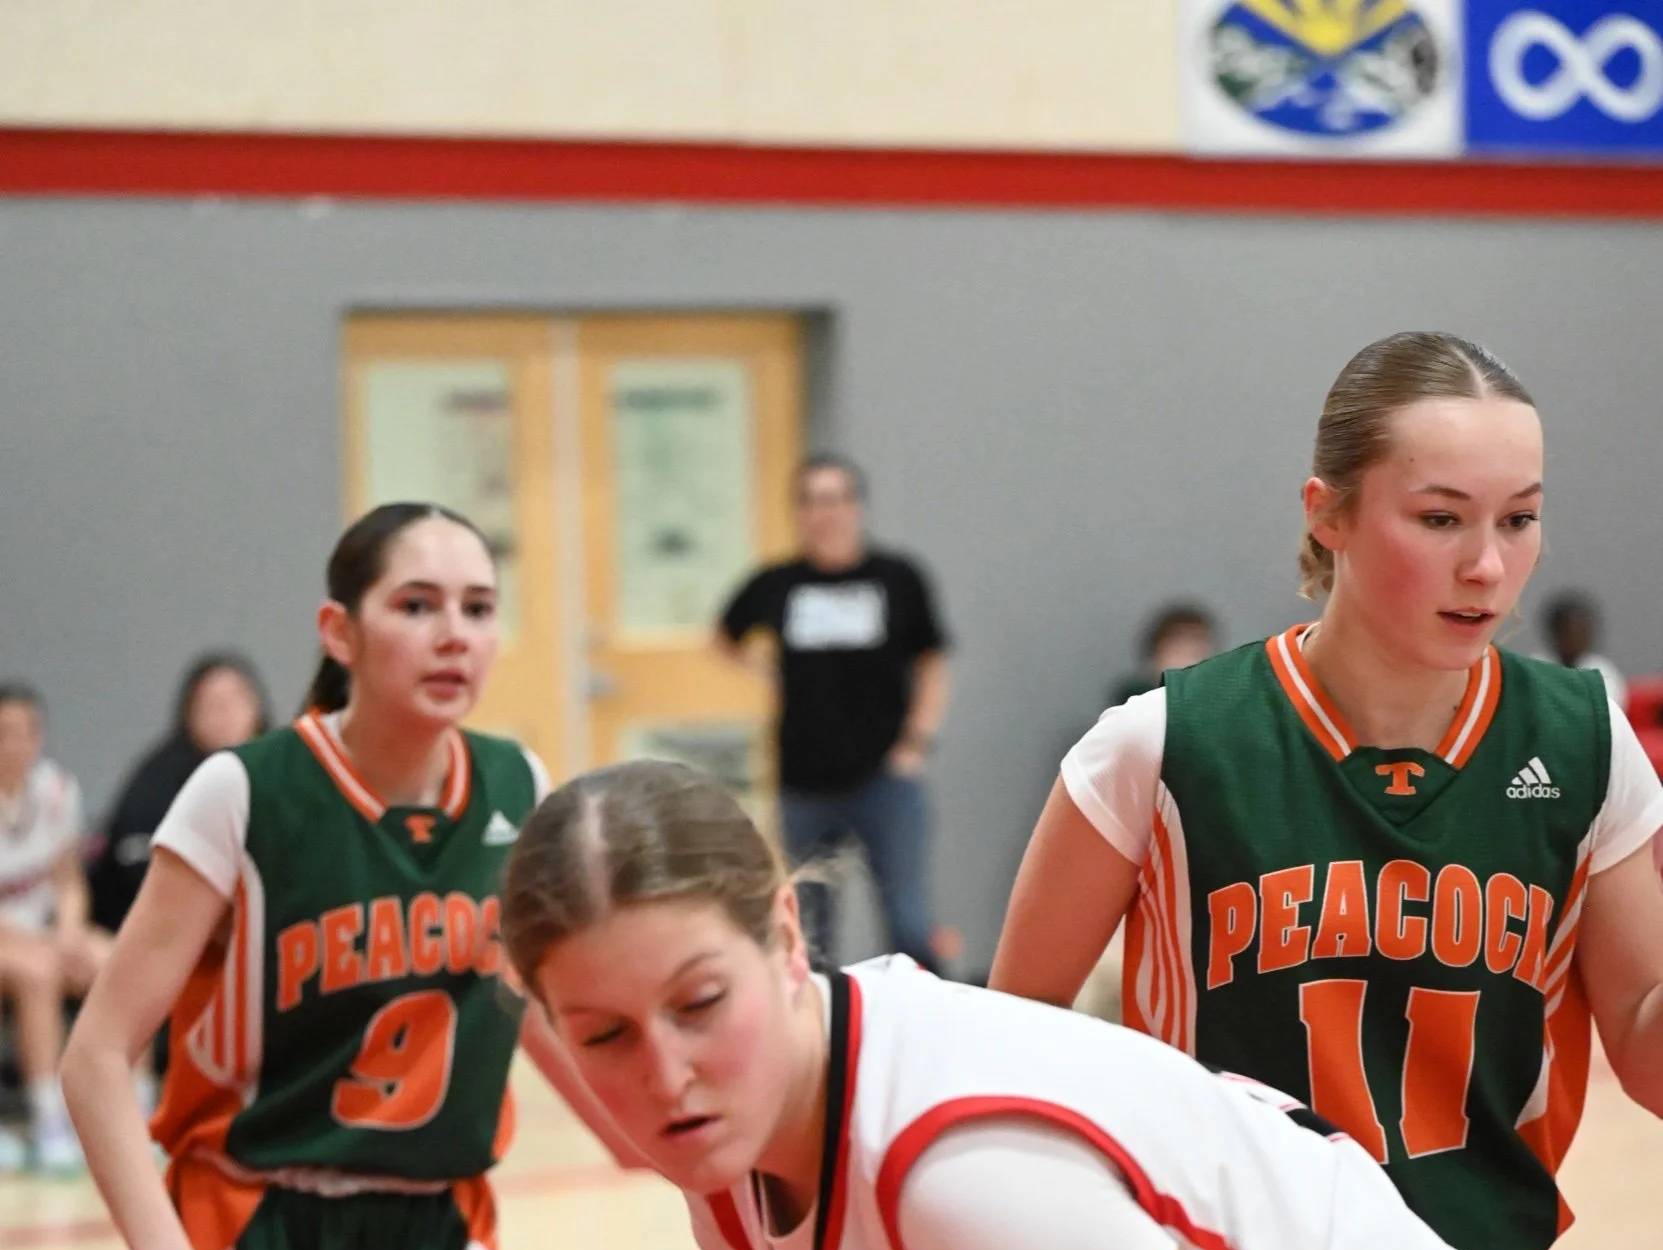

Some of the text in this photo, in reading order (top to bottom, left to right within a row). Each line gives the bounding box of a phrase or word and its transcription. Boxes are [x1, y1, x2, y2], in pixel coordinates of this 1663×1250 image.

[1375, 761, 1425, 796] T
[1505, 783, 1561, 799] adidas
[331, 988, 458, 1131] 9
[1299, 978, 1481, 1165] 11
